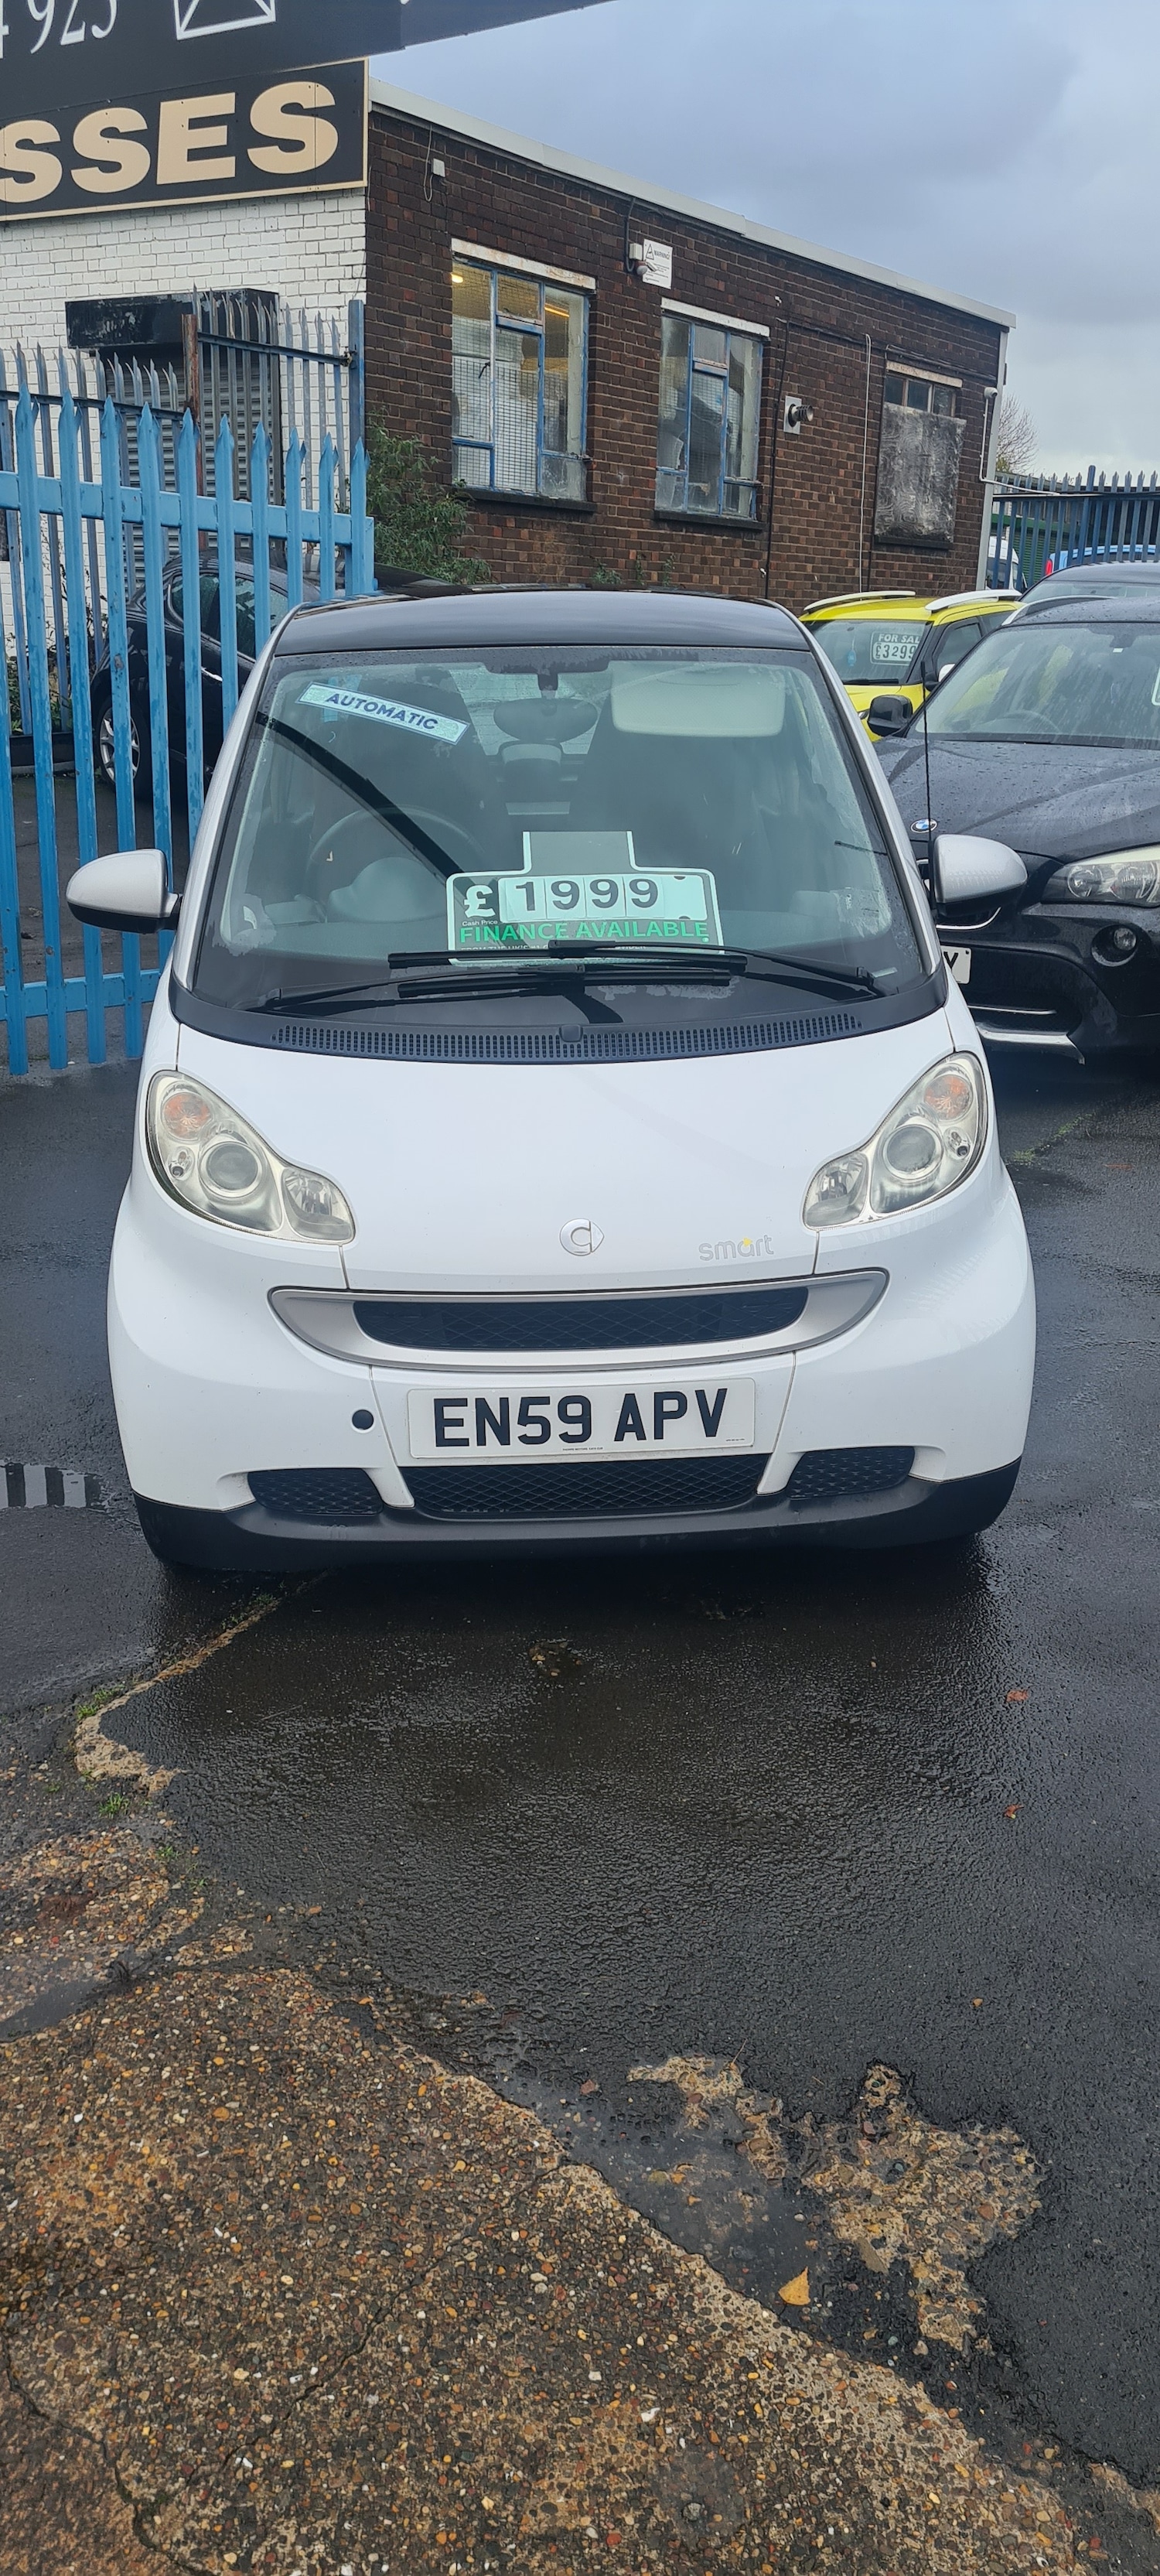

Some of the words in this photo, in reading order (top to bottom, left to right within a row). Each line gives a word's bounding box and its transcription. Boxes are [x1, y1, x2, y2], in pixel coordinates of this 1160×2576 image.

[0, 81, 339, 203] SSES
[879, 634, 899, 642] FOR
[901, 635, 920, 644] SAL
[325, 693, 438, 730] AUTOMATIC
[459, 921, 569, 943] FINANCE
[575, 921, 710, 941] AVAILABLE
[698, 1235, 775, 1262] smart
[433, 1395, 592, 1447] EN59
[613, 1388, 728, 1443] APV
